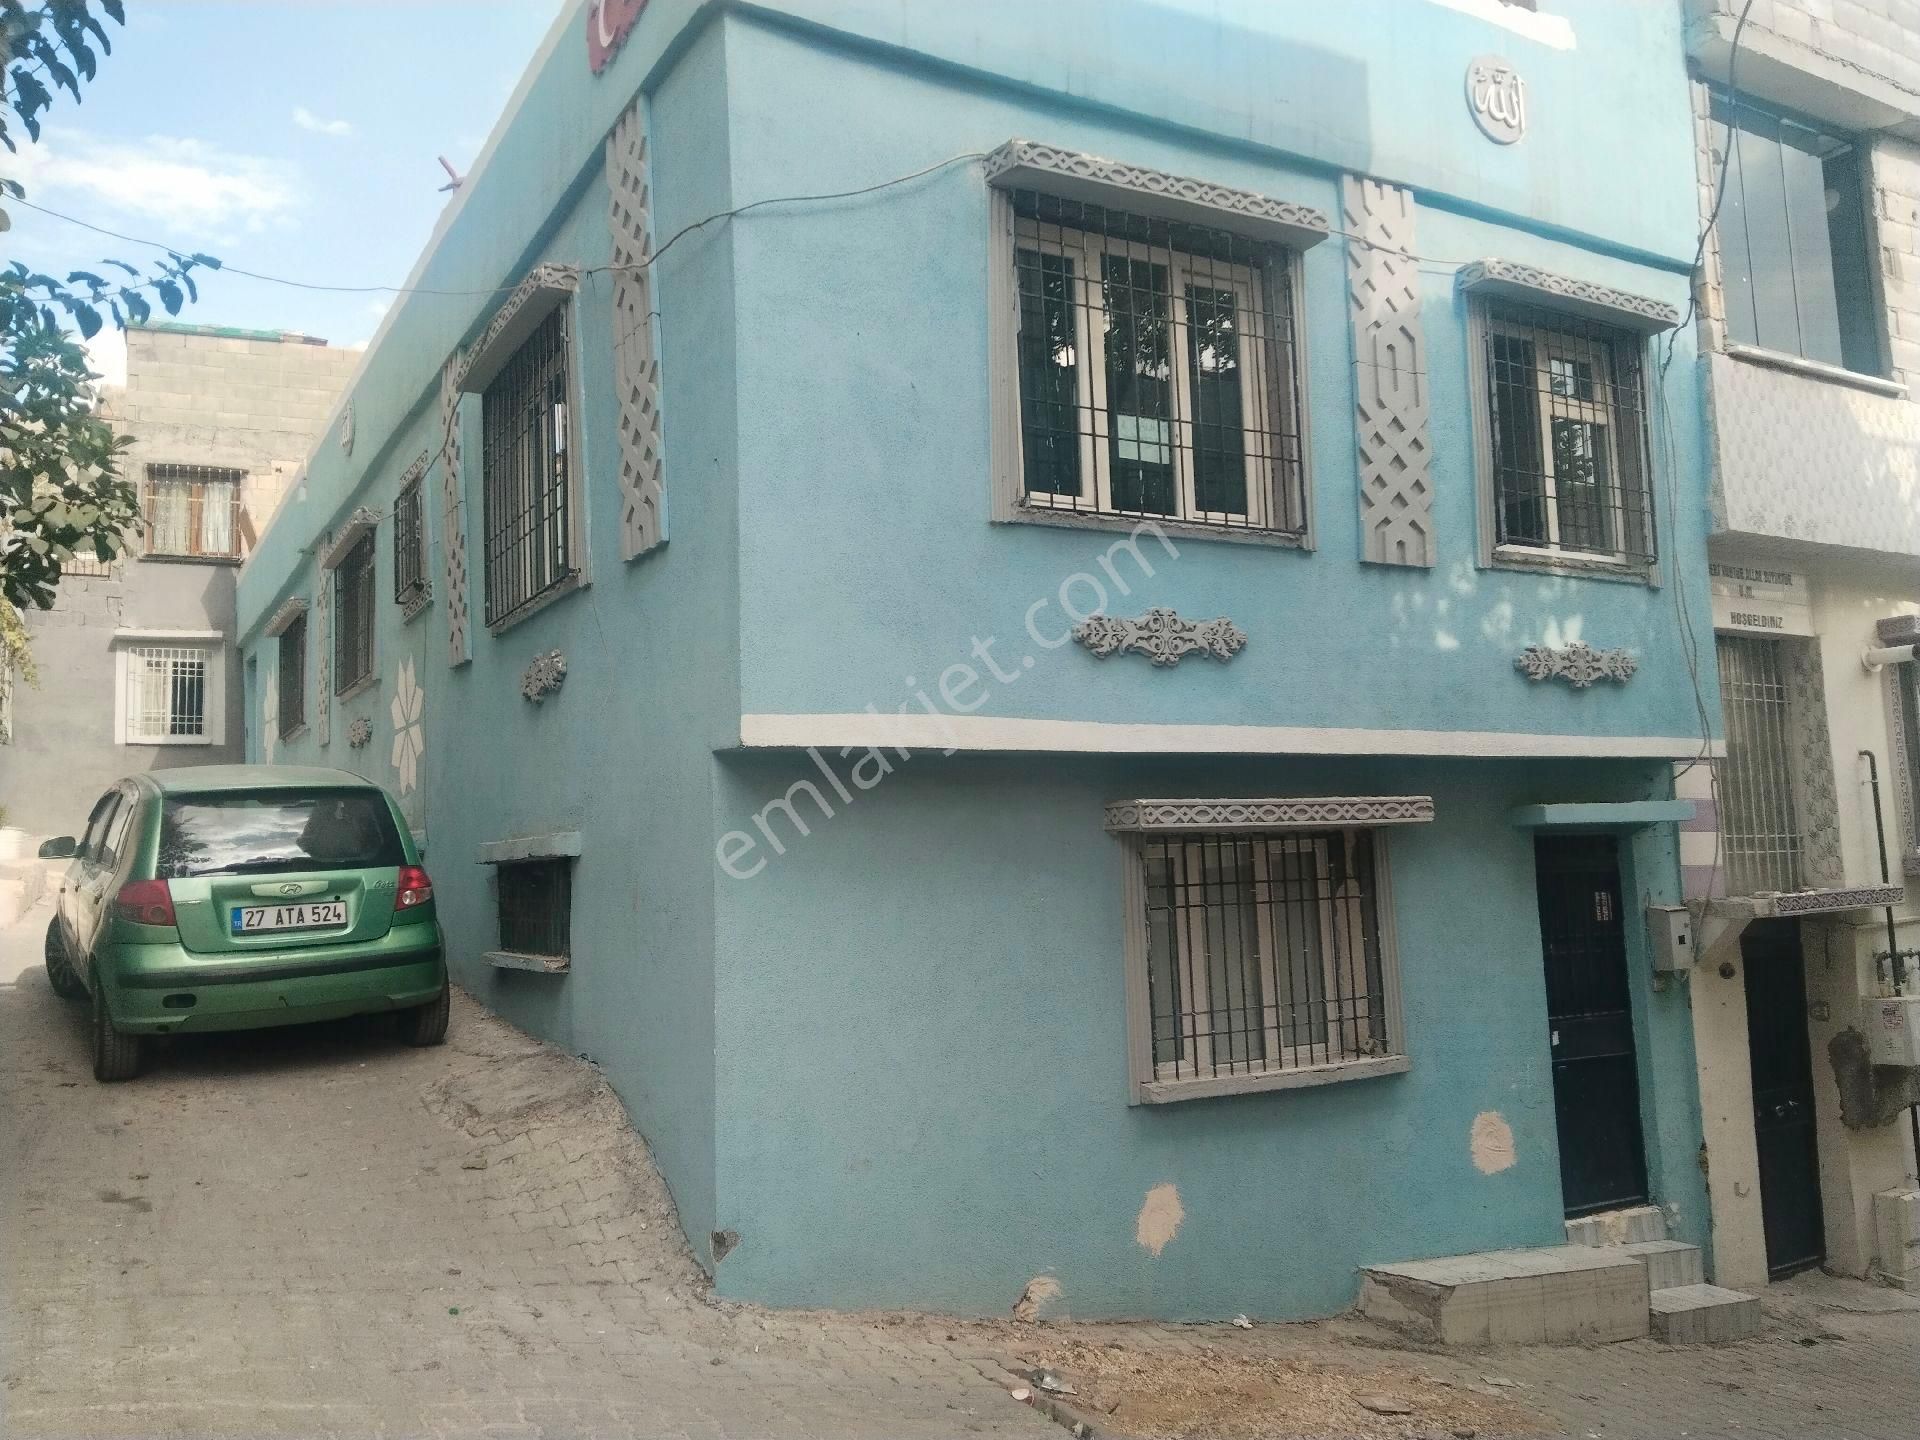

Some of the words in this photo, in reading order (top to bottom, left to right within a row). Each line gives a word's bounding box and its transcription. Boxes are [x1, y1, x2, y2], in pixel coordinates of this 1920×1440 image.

[245, 910, 265, 928] 27
[275, 907, 305, 926] ATA
[311, 905, 342, 923] 524
